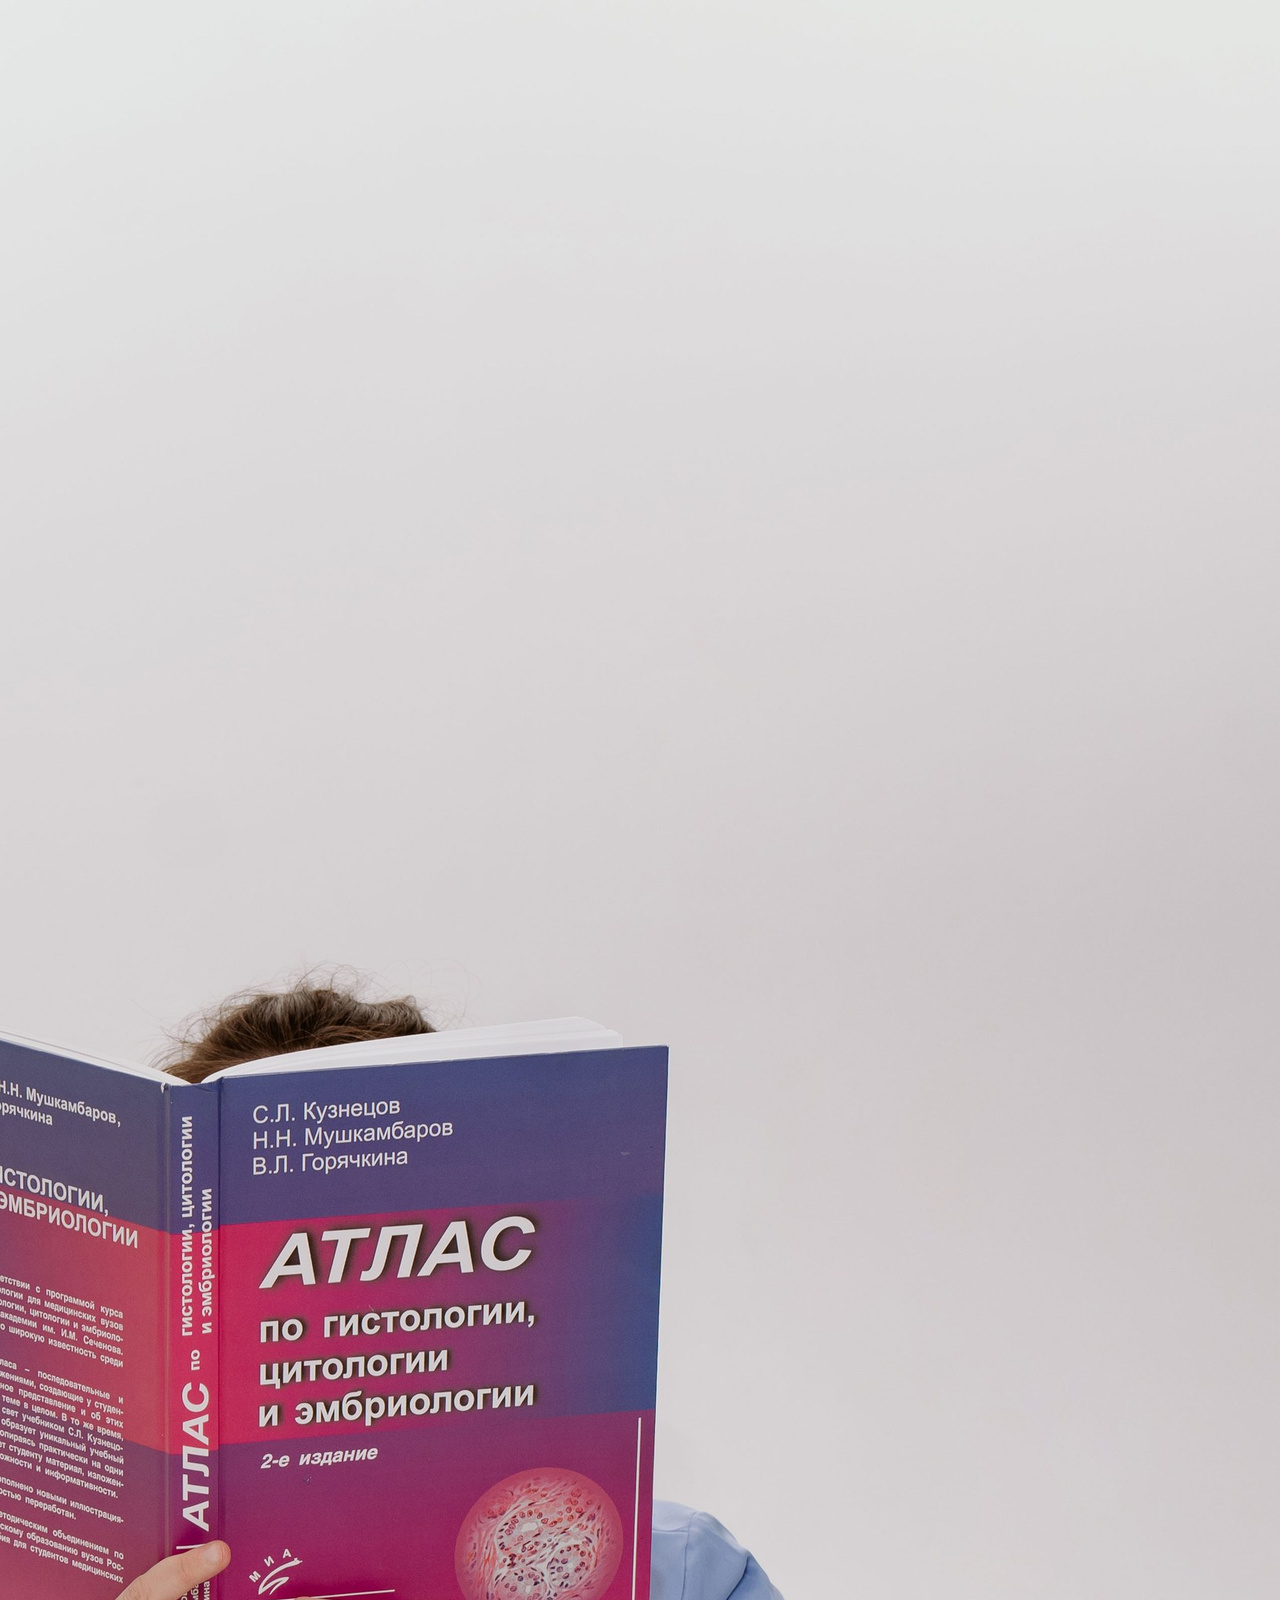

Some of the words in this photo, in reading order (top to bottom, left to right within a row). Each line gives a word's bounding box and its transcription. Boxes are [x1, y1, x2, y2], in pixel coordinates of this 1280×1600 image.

[26, 1087, 121, 1127] Мушкамбаров,
[252, 1105, 296, 1124] С.Л.
[303, 1100, 401, 1125] Кузнецов
[252, 1129, 297, 1149] Н.Н.
[304, 1121, 454, 1149] Мушкамбаров
[181, 1115, 194, 1218] цитологии
[252, 1155, 294, 1175] В.Л.
[301, 1150, 408, 1175] Горячкина
[198, 1188, 215, 1317] эмбриологии
[258, 1216, 536, 1289] АТЛАС
[182, 1223, 195, 1336] гистологии,
[27, 1295, 41, 1306] для
[44, 1300, 96, 1323] медицинских
[100, 1318, 123, 1331] вузов
[46, 1289, 95, 1310] программой
[100, 1305, 123, 1319] курса
[260, 1318, 303, 1343] по
[324, 1301, 536, 1338] гистологии,
[0, 1311, 37, 1329] академии
[42, 1324, 56, 1334] им.
[61, 1328, 78, 1341] И.М.
[83, 1335, 123, 1356] Сеченова.
[29, 1308, 70, 1327] цитологии
[73, 1321, 79, 1329] и
[81, 1324, 123, 1342] эмбриоло-
[202, 1323, 212, 1334] и
[9, 1326, 45, 1343] широкую
[48, 1338, 97, 1359] известность
[100, 1354, 123, 1368] среди
[190, 1350, 200, 1371] по
[37, 1370, 110, 1400] последовательные
[259, 1349, 449, 1389] цитологии
[1, 1394, 21, 1407] теме
[31, 1404, 58, 1419] целом.
[61, 1412, 68, 1422] В
[70, 1417, 80, 1426] то
[82, 1421, 94, 1431] же
[97, 1425, 124, 1442] время,
[18, 1388, 76, 1413] представление
[81, 1408, 86, 1416] и
[90, 1411, 101, 1421] об
[105, 1416, 124, 1428] этих
[39, 1383, 84, 1403] создающие
[94, 1401, 124, 1415] студен-
[259, 1404, 278, 1428] и
[294, 1384, 534, 1427] эмбриологии
[182, 1382, 209, 1532] АТЛАС
[260, 1453, 290, 1469] 2-е
[298, 1446, 378, 1467] издание
[25, 1496, 76, 1520] переработан.
[36, 1489, 67, 1505] новыми
[70, 1500, 124, 1523] иллюстрация-
[13, 1539, 27, 1550] для
[30, 1545, 69, 1564] студентов
[72, 1559, 123, 1584] медицинских
[26, 1532, 79, 1556] образованию
[81, 1551, 104, 1565] вузов
[106, 1558, 124, 1571] Рос-
[52, 1529, 109, 1555] объединением
[114, 1551, 124, 1560] по
